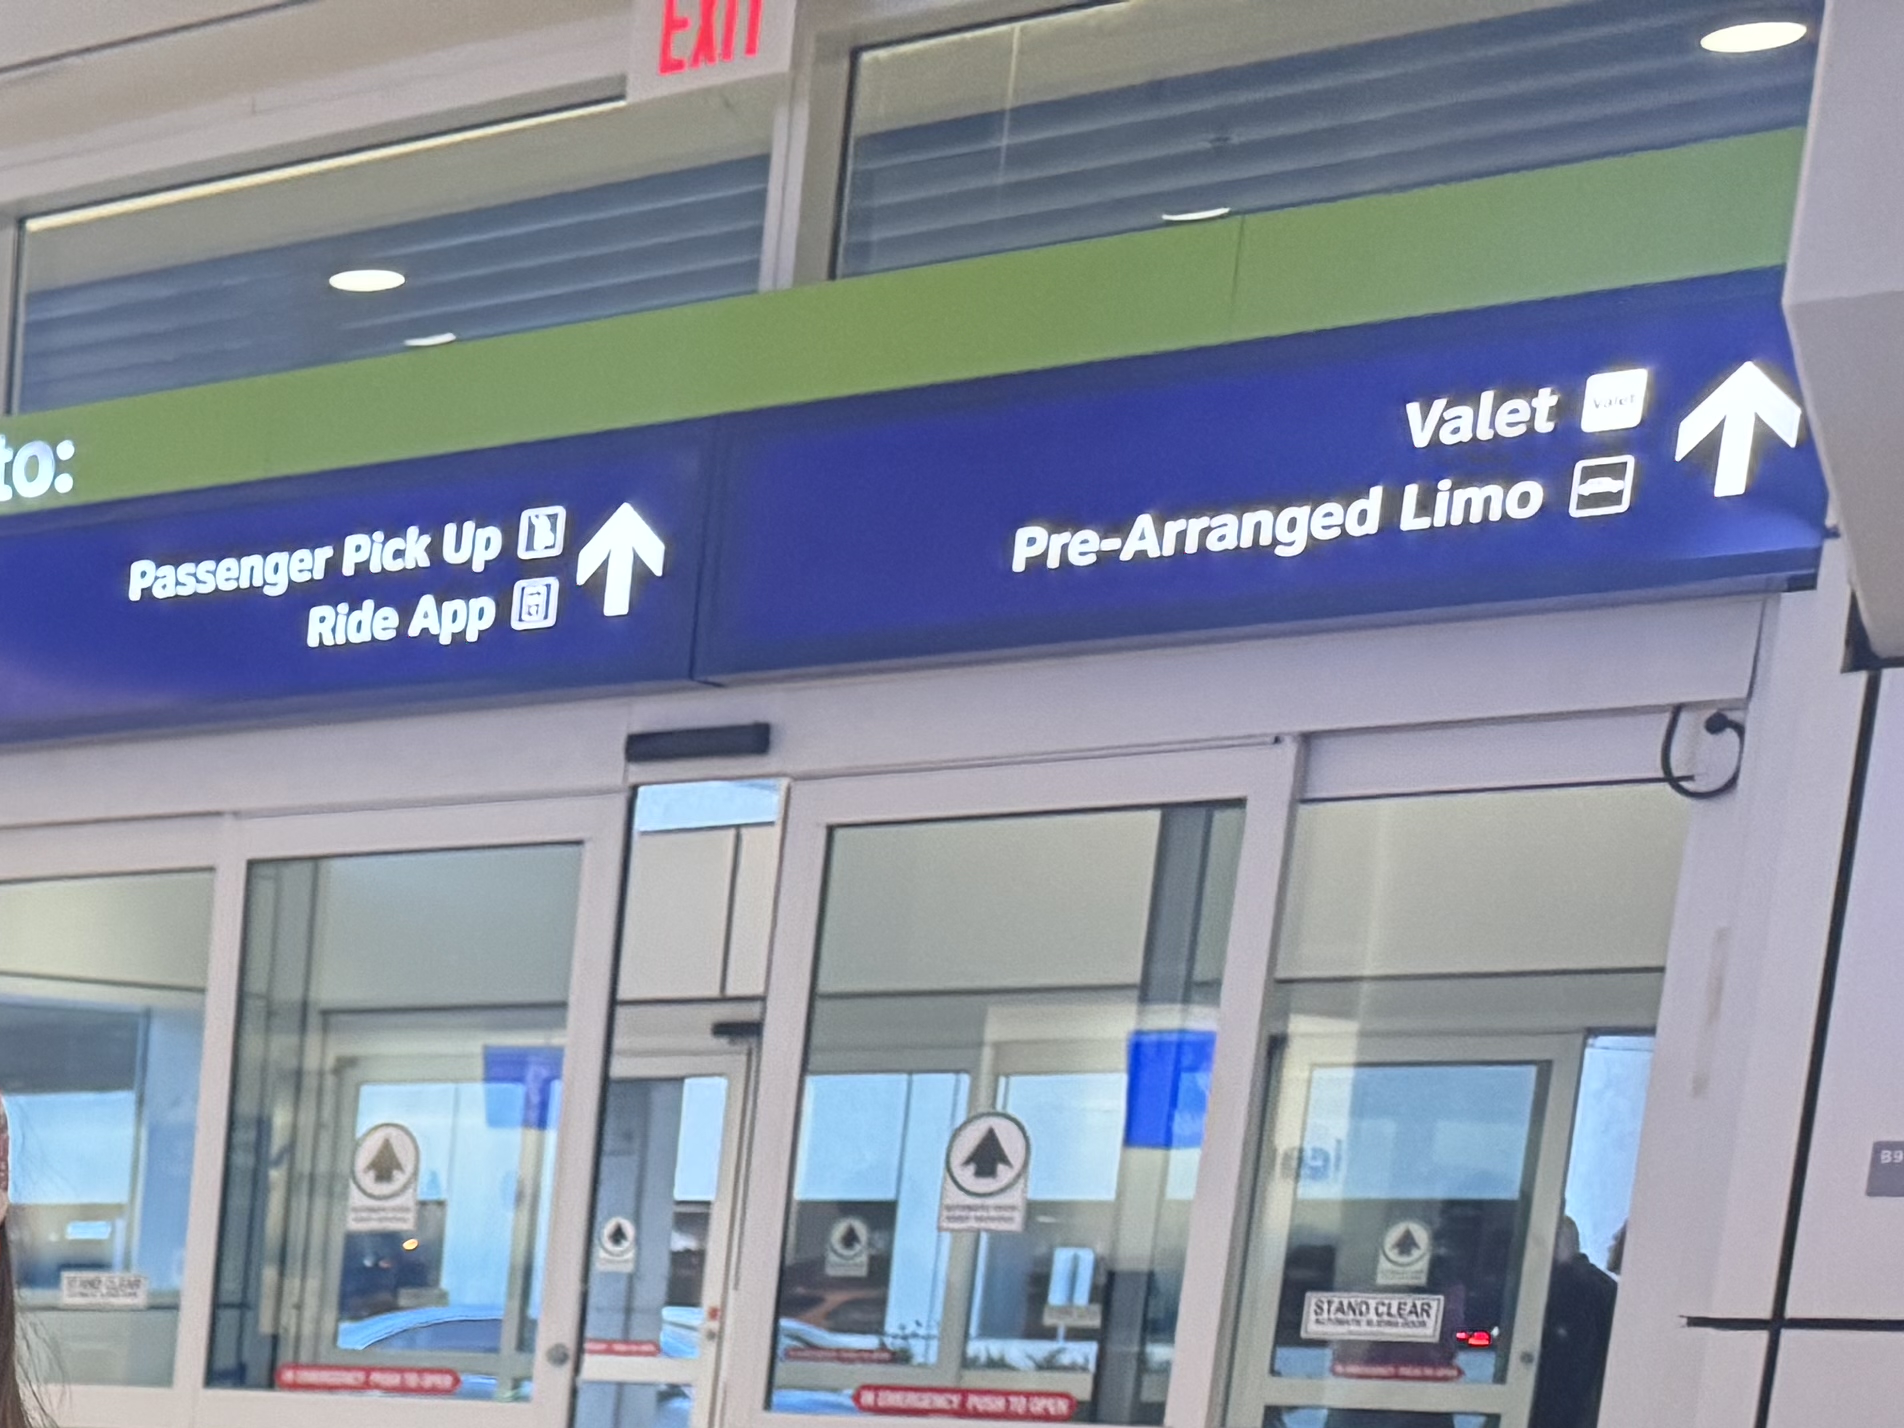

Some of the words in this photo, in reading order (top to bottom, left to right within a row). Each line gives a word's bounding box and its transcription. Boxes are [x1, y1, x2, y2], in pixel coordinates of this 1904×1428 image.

[1405, 386, 1558, 449] Valet
[1011, 485, 1383, 573] Pre-Arranged
[1399, 478, 1544, 532] Limo
[128, 545, 335, 602] Passenger
[341, 525, 432, 577] Pick
[441, 519, 503, 574] Up
[306, 598, 400, 648] Ride
[407, 593, 496, 646] App
[1313, 1299, 1370, 1317] STAND
[1374, 1301, 1432, 1319] CLEAR
[965, 1393, 1007, 1412] PUSH
[1028, 1396, 1071, 1415] OPEN
